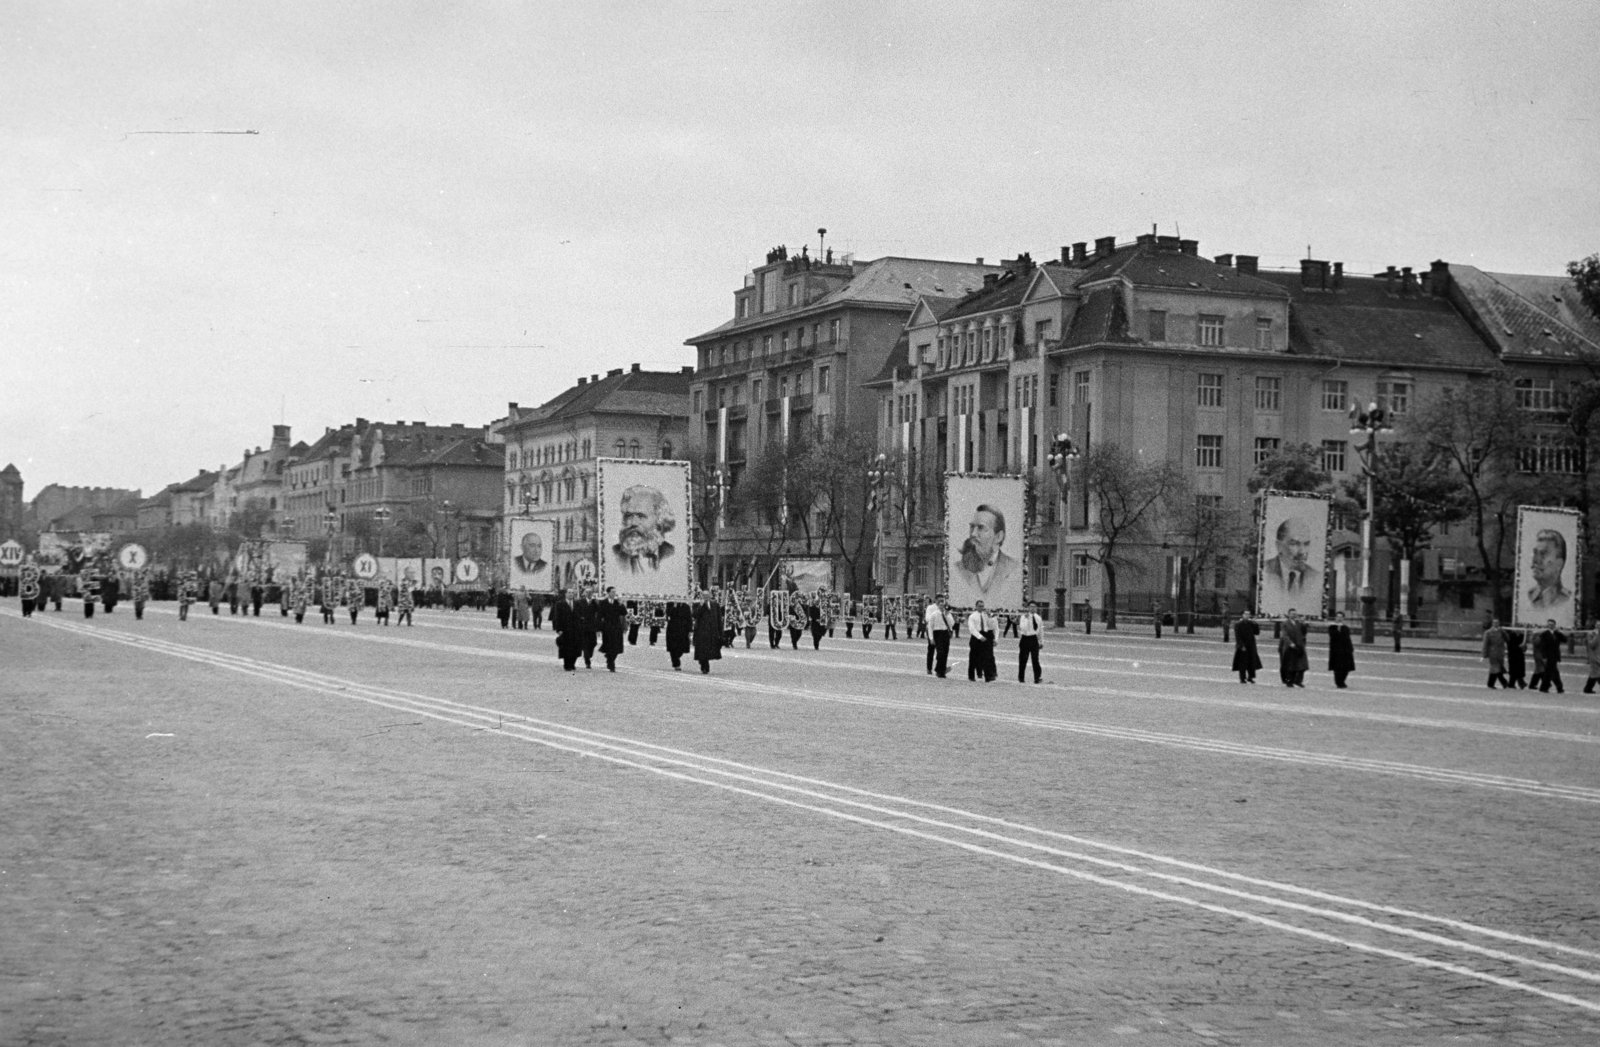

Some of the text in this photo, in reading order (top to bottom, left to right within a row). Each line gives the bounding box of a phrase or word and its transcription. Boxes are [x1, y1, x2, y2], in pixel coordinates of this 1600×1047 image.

[1, 547, 22, 561] XIV
[128, 550, 137, 564] X
[360, 560, 372, 573] XI
[463, 564, 471, 577] V
